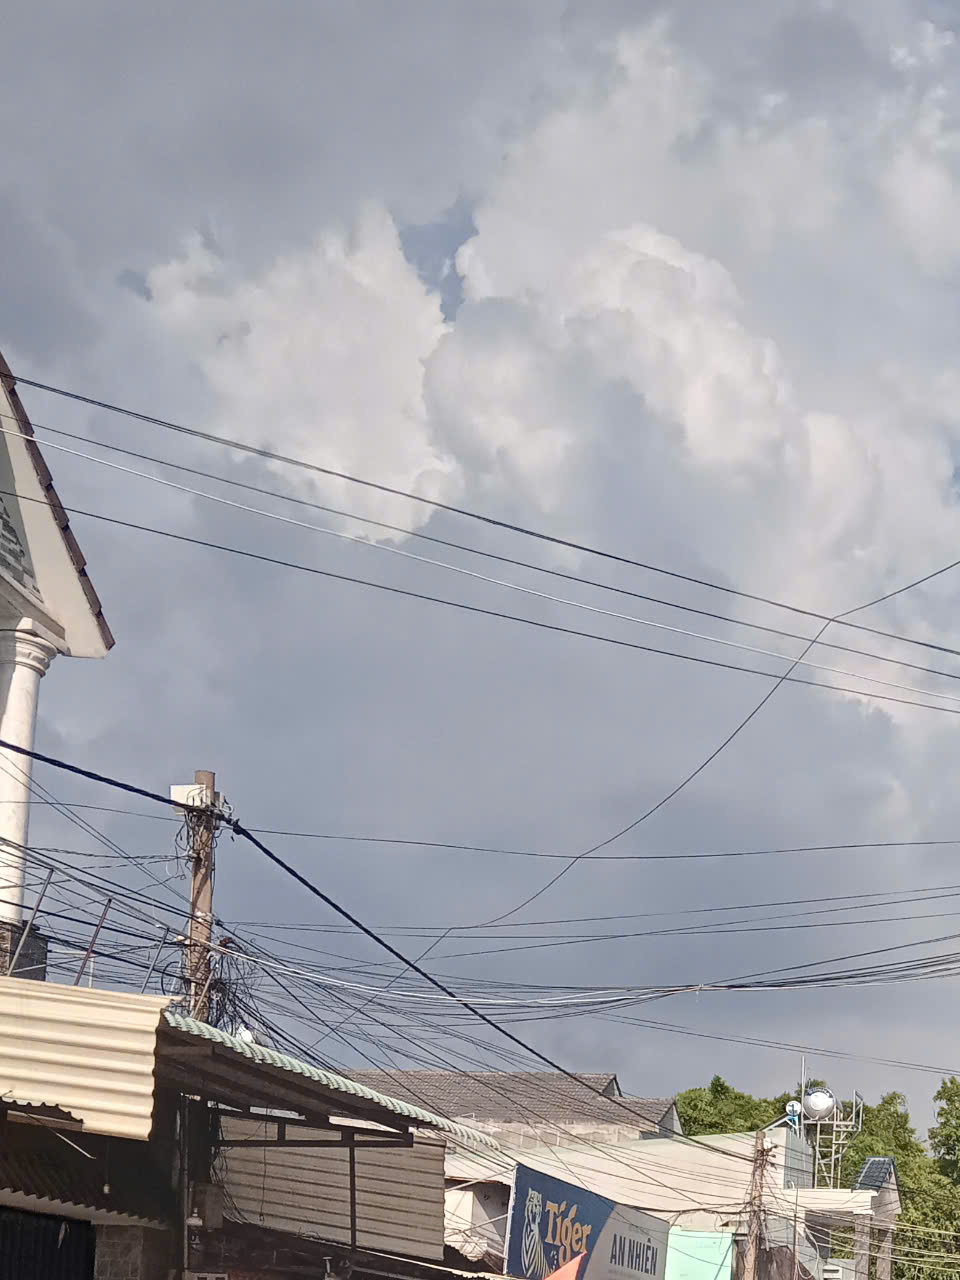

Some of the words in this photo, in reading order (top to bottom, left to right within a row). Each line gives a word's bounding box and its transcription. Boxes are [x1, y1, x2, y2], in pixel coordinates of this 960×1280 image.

[544, 1200, 592, 1265] Tiger
[609, 1233, 626, 1267] AN
[627, 1237, 658, 1276] NHIÊN
